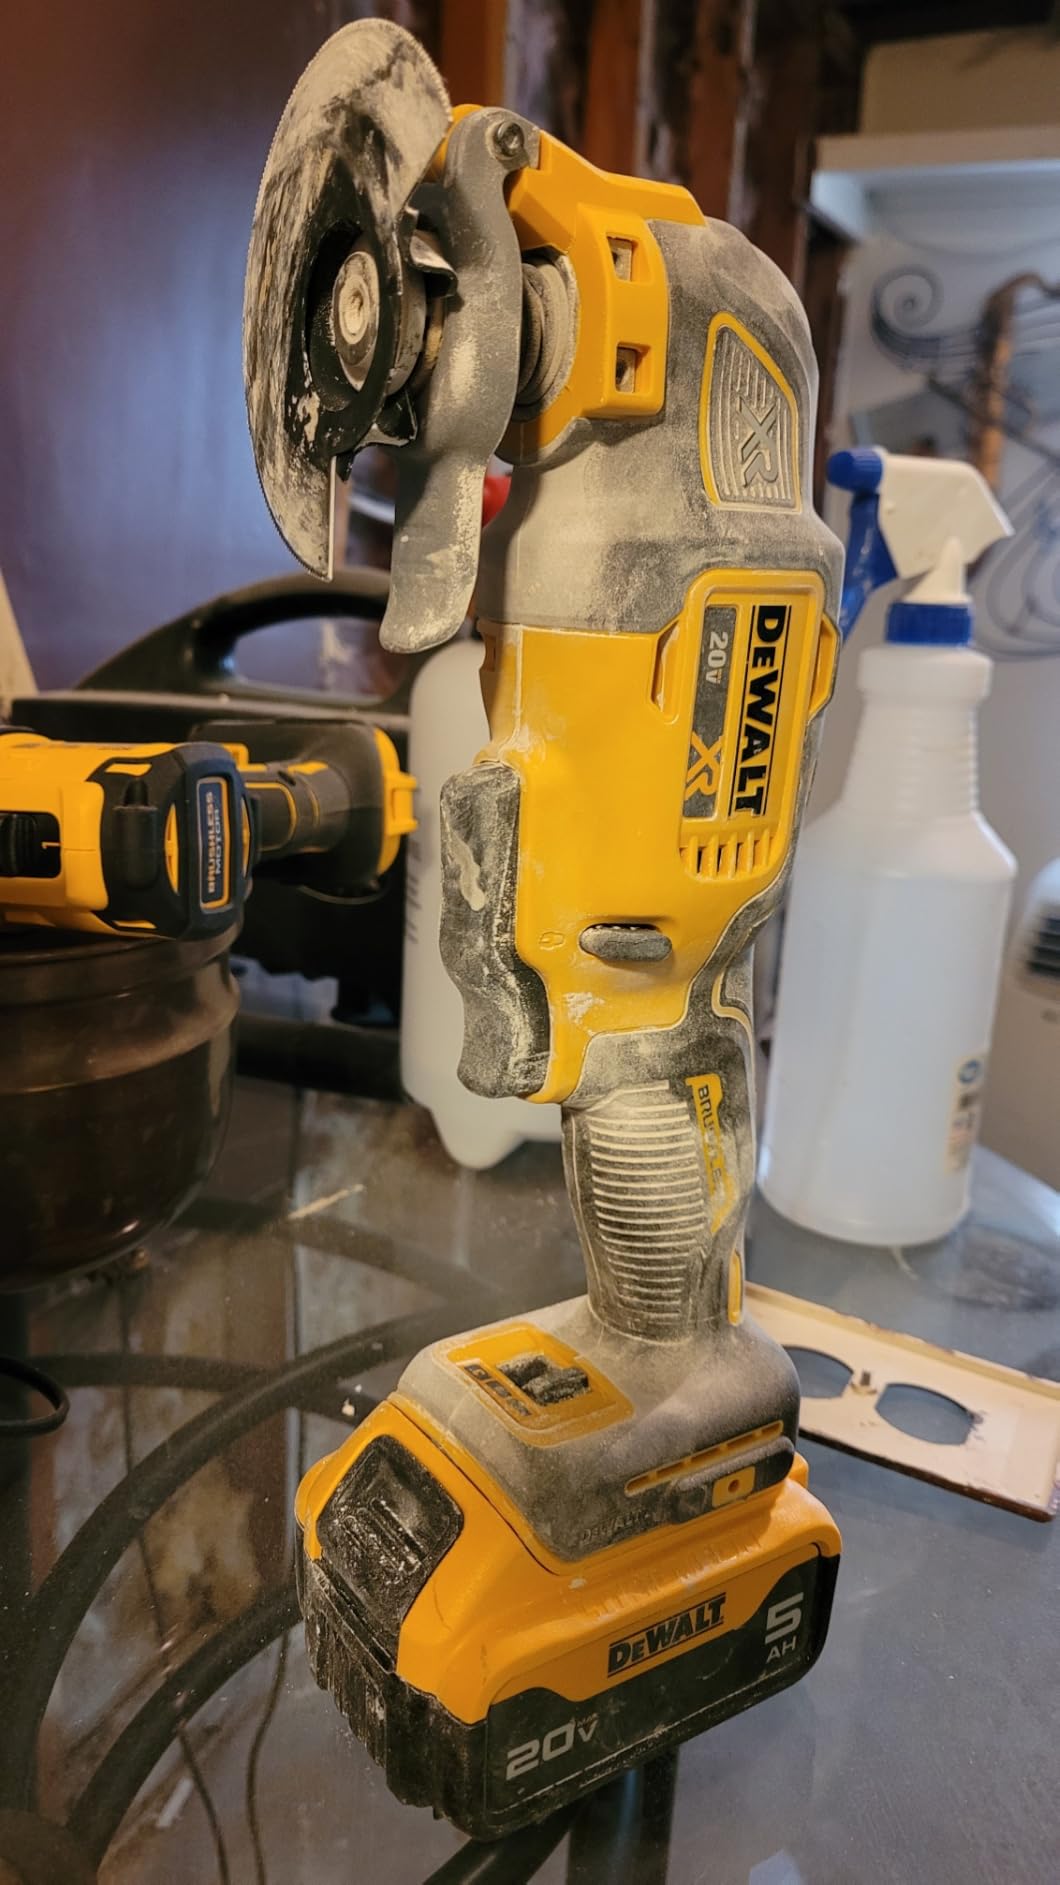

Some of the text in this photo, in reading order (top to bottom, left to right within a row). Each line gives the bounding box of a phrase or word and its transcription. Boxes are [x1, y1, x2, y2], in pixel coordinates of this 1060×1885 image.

[739, 396, 778, 487] XR
[706, 631, 729, 685] 20V
[732, 605, 791, 816] DEWALT
[685, 730, 724, 801] XR
[206, 791, 216, 893] BRUSHLESS
[214, 809, 222, 875] MOTOR
[607, 1594, 726, 1677] DEWALT
[765, 1592, 804, 1644] 5
[766, 1636, 797, 1663] AH
[506, 1718, 598, 1781] 20V
